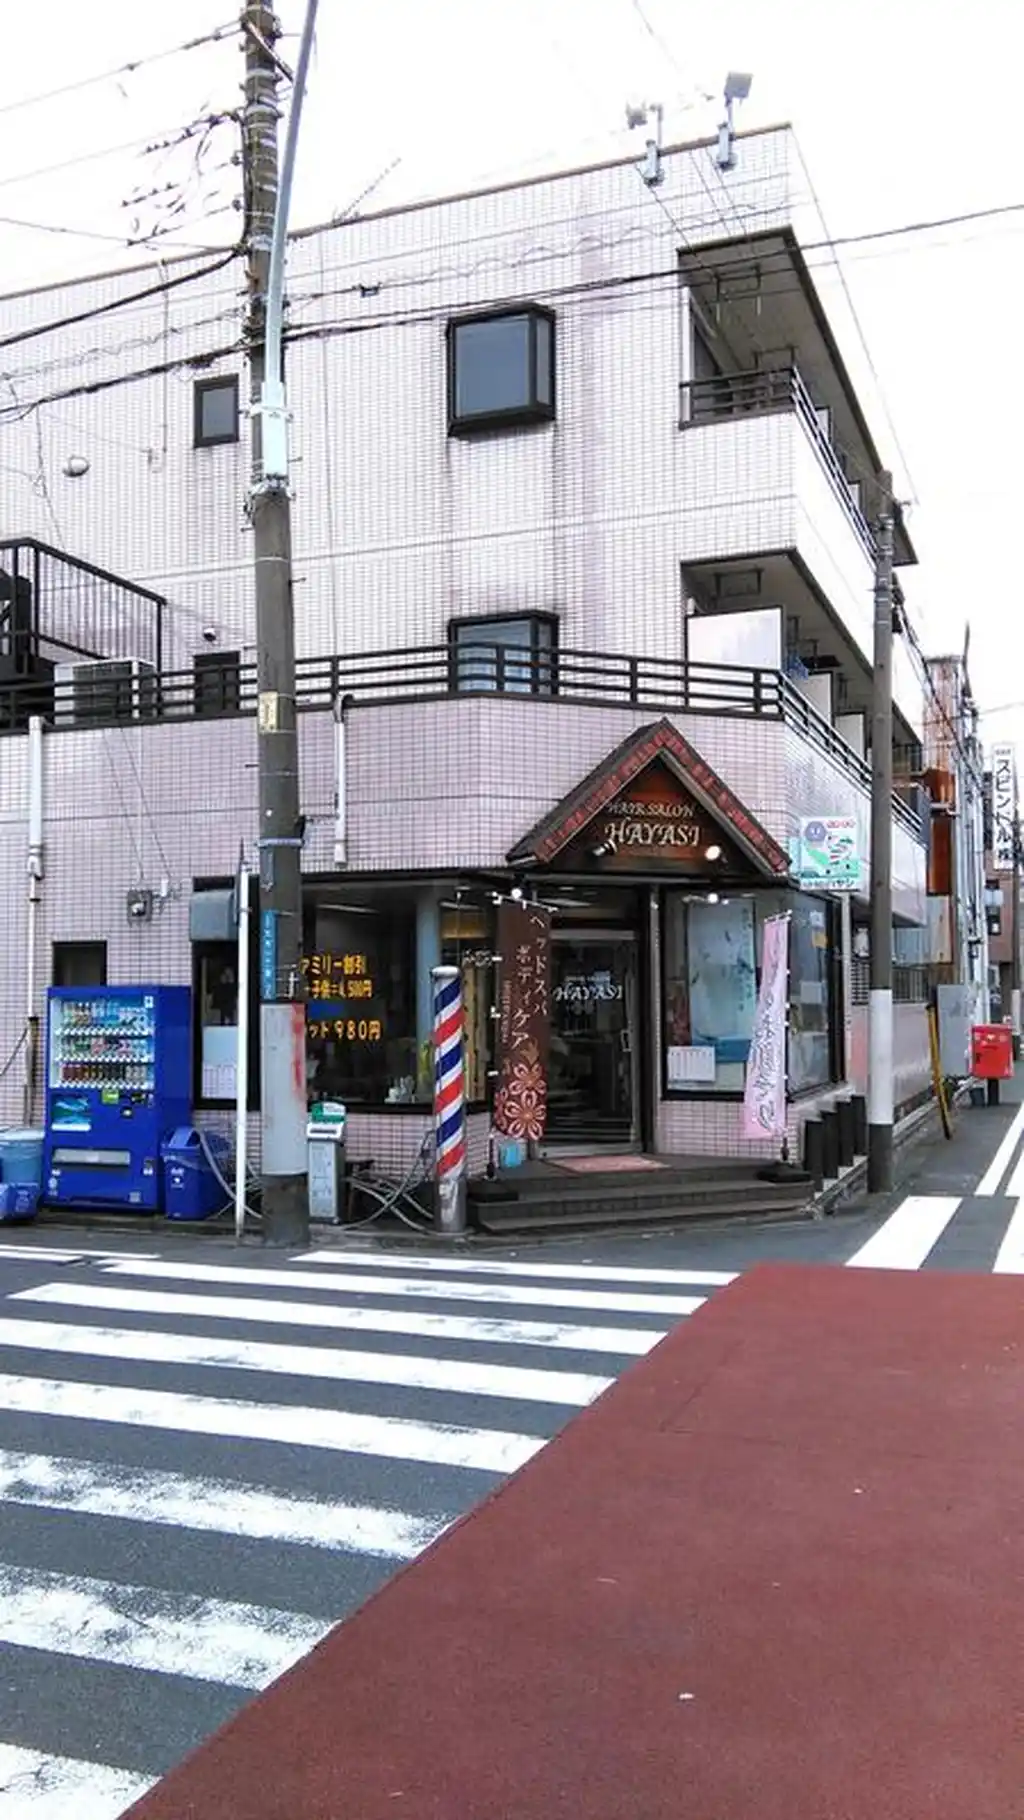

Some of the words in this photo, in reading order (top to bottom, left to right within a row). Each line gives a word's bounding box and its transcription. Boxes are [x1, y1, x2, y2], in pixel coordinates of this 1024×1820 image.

[646, 802, 694, 818] SALON
[604, 817, 700, 846] HAYASI
[530, 915, 548, 1017] ヘッドスパ
[511, 944, 533, 1050] ボディケア
[552, 982, 623, 1001] HAYASI
